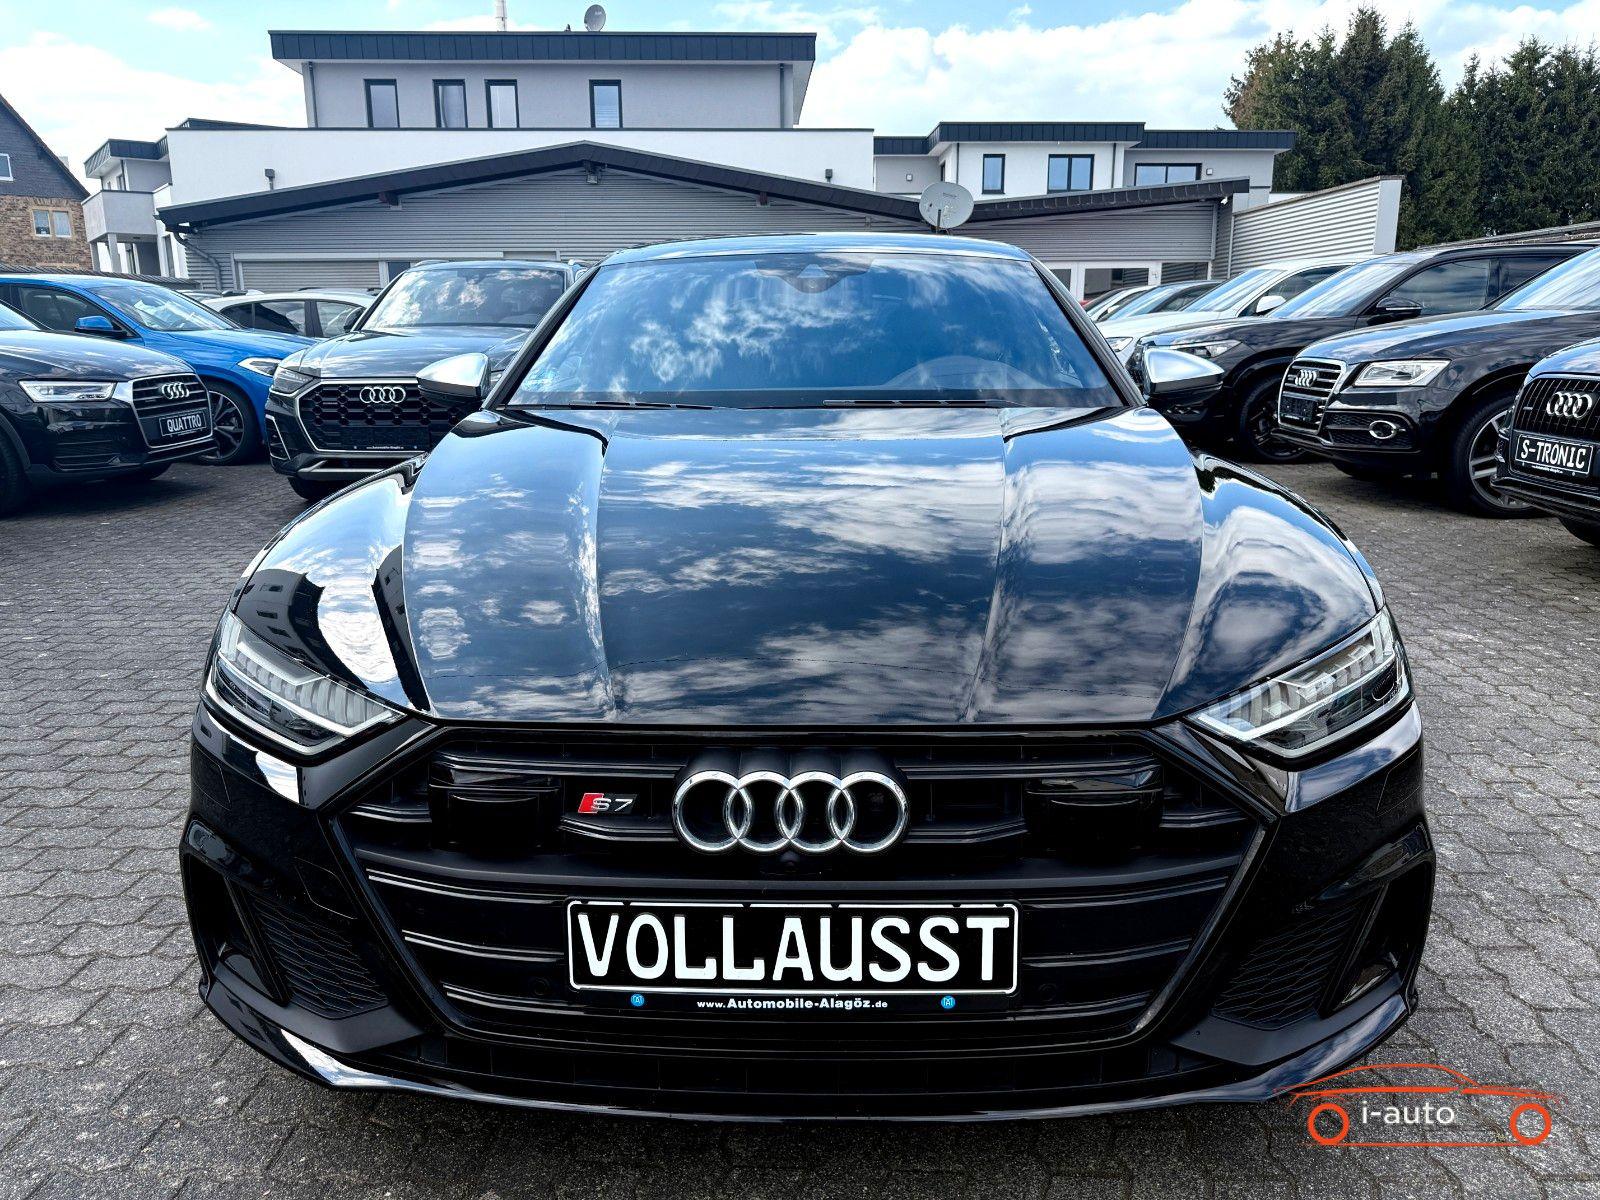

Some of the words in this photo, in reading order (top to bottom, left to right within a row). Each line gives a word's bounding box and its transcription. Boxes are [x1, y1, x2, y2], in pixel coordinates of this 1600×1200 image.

[166, 414, 202, 433] QUATTRO
[1520, 439, 1587, 469] S-TRONIC
[591, 797, 634, 812] S7
[577, 912, 1010, 983] VOLLAUSST
[697, 997, 888, 1010] www.Automobile-Alagöz.de
